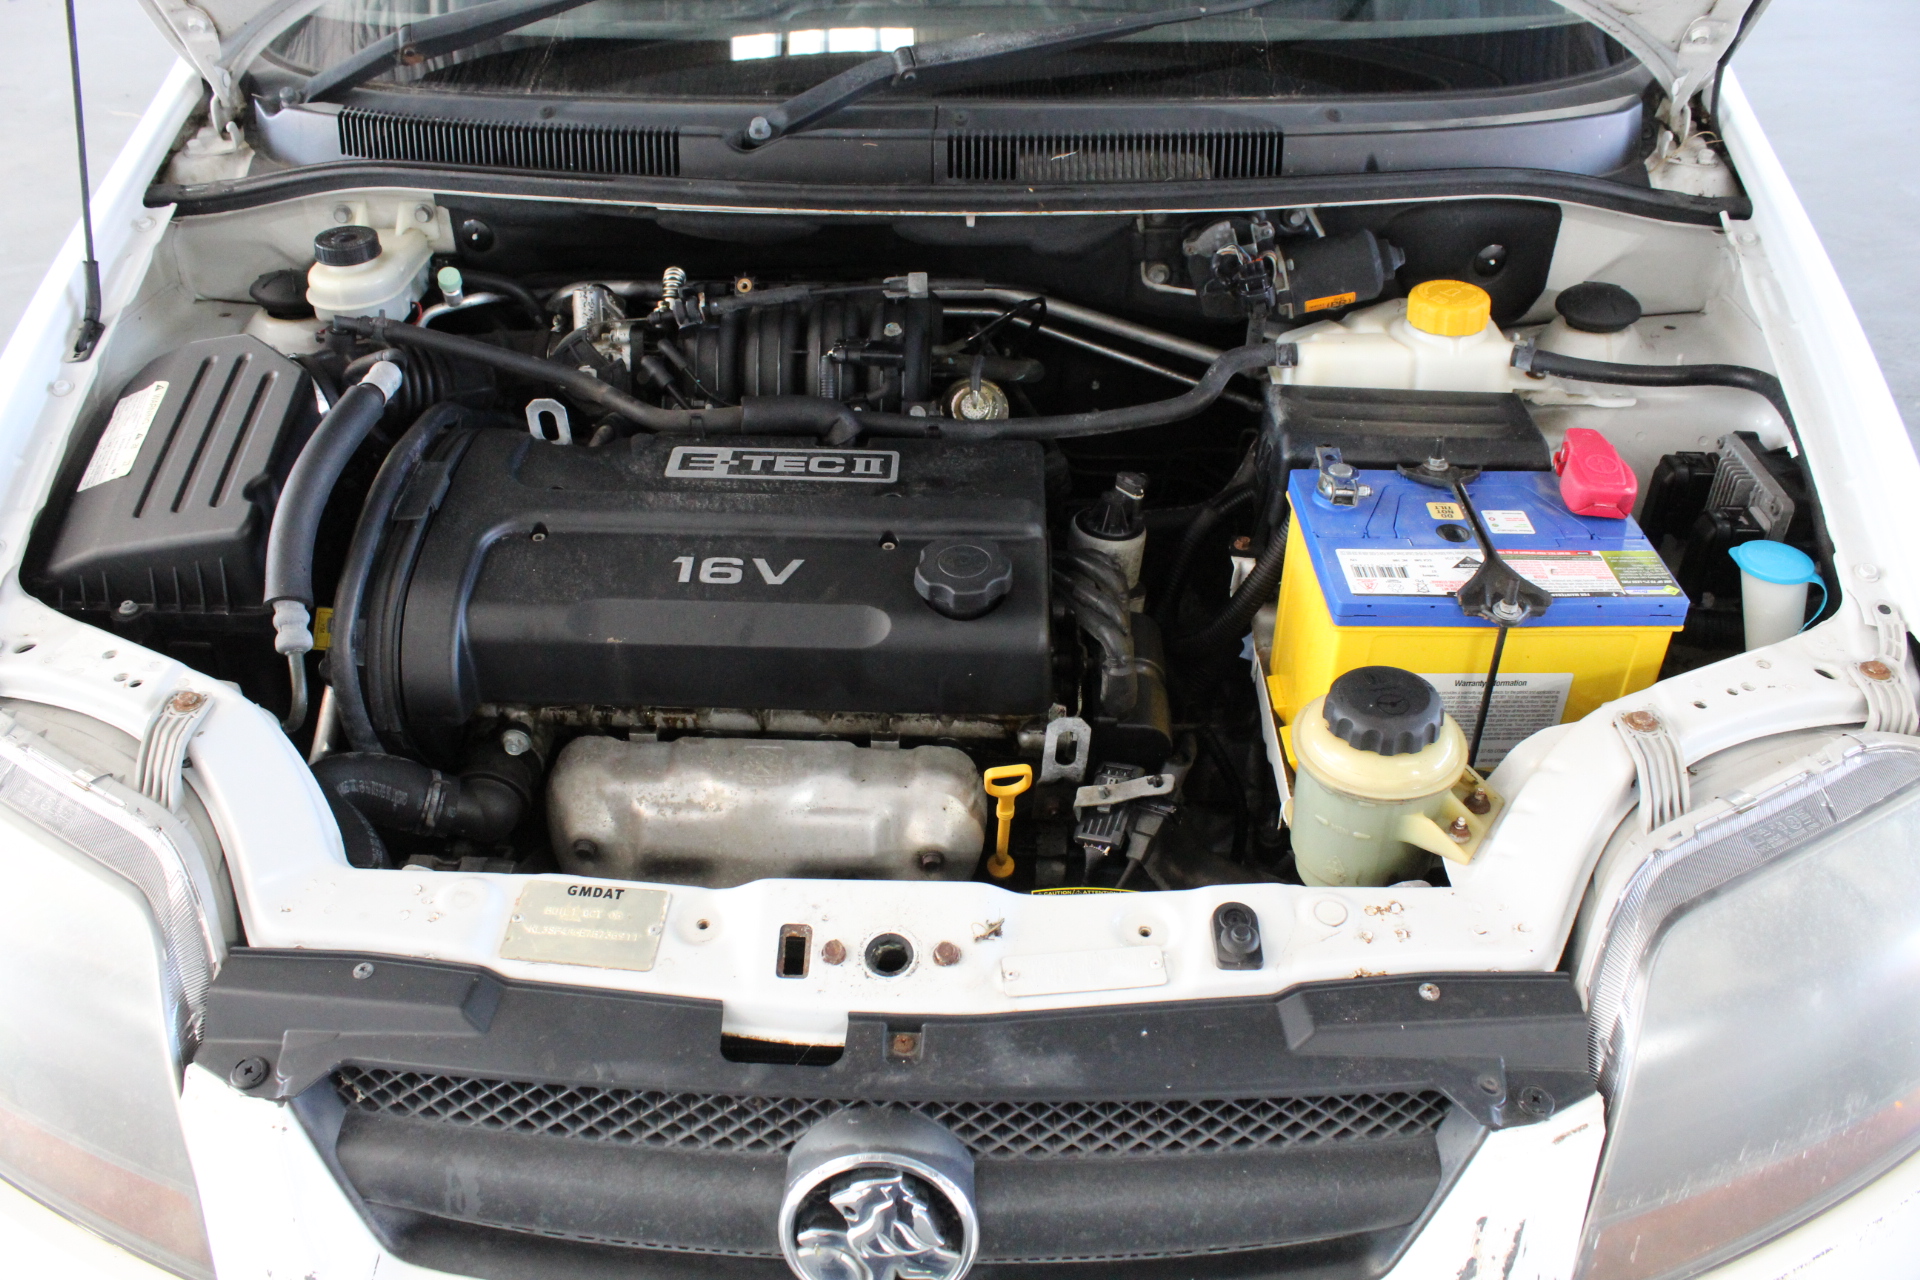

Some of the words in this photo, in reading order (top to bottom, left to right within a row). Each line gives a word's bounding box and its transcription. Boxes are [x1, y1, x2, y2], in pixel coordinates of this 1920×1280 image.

[672, 556, 805, 585] 16V
[1454, 680, 1487, 688] Warranty
[1492, 679, 1528, 688] formation
[567, 885, 625, 900] GMDAT
